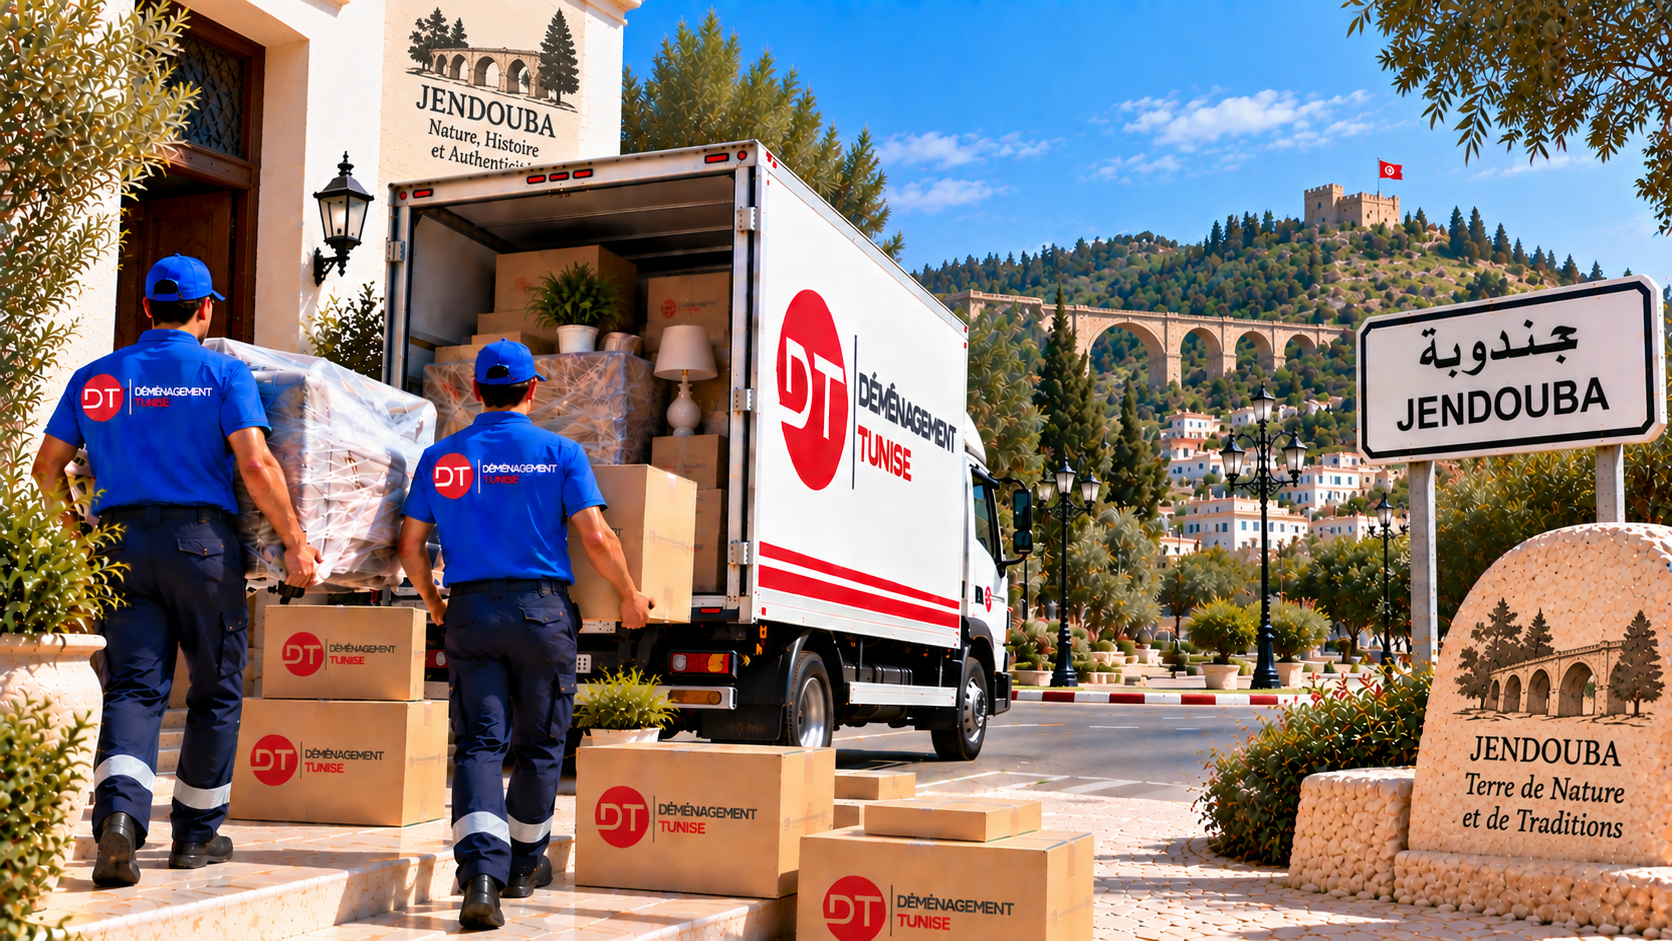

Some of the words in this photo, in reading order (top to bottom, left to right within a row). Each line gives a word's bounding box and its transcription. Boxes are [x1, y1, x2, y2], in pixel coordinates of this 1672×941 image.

[416, 84, 556, 138] JENDOUBA
[428, 118, 480, 147] Nature,
[485, 131, 539, 157] Histoire
[431, 145, 445, 159] et
[448, 146, 531, 170] Authenti
[1419, 319, 1579, 378] جندوبة
[83, 388, 120, 409] DT
[779, 336, 846, 441] DT
[1396, 377, 1610, 431] JENDOUBA
[857, 424, 912, 482] TUNISE
[435, 466, 470, 487] DT
[284, 645, 321, 665] DT
[329, 656, 365, 665] TUNISE
[251, 749, 294, 771] DT
[1470, 735, 1622, 767] JENDOUBA
[305, 762, 344, 773] TUNISE
[1465, 772, 1515, 798] Terre
[1521, 774, 1544, 799] de
[1550, 776, 1625, 804] Nature
[596, 803, 644, 832] DT
[658, 820, 706, 835] TUNISE
[1462, 808, 1481, 829] et
[1486, 806, 1510, 831] de
[1517, 808, 1624, 839] Traditions
[824, 894, 882, 927] DT
[897, 914, 951, 931] TUNISE
